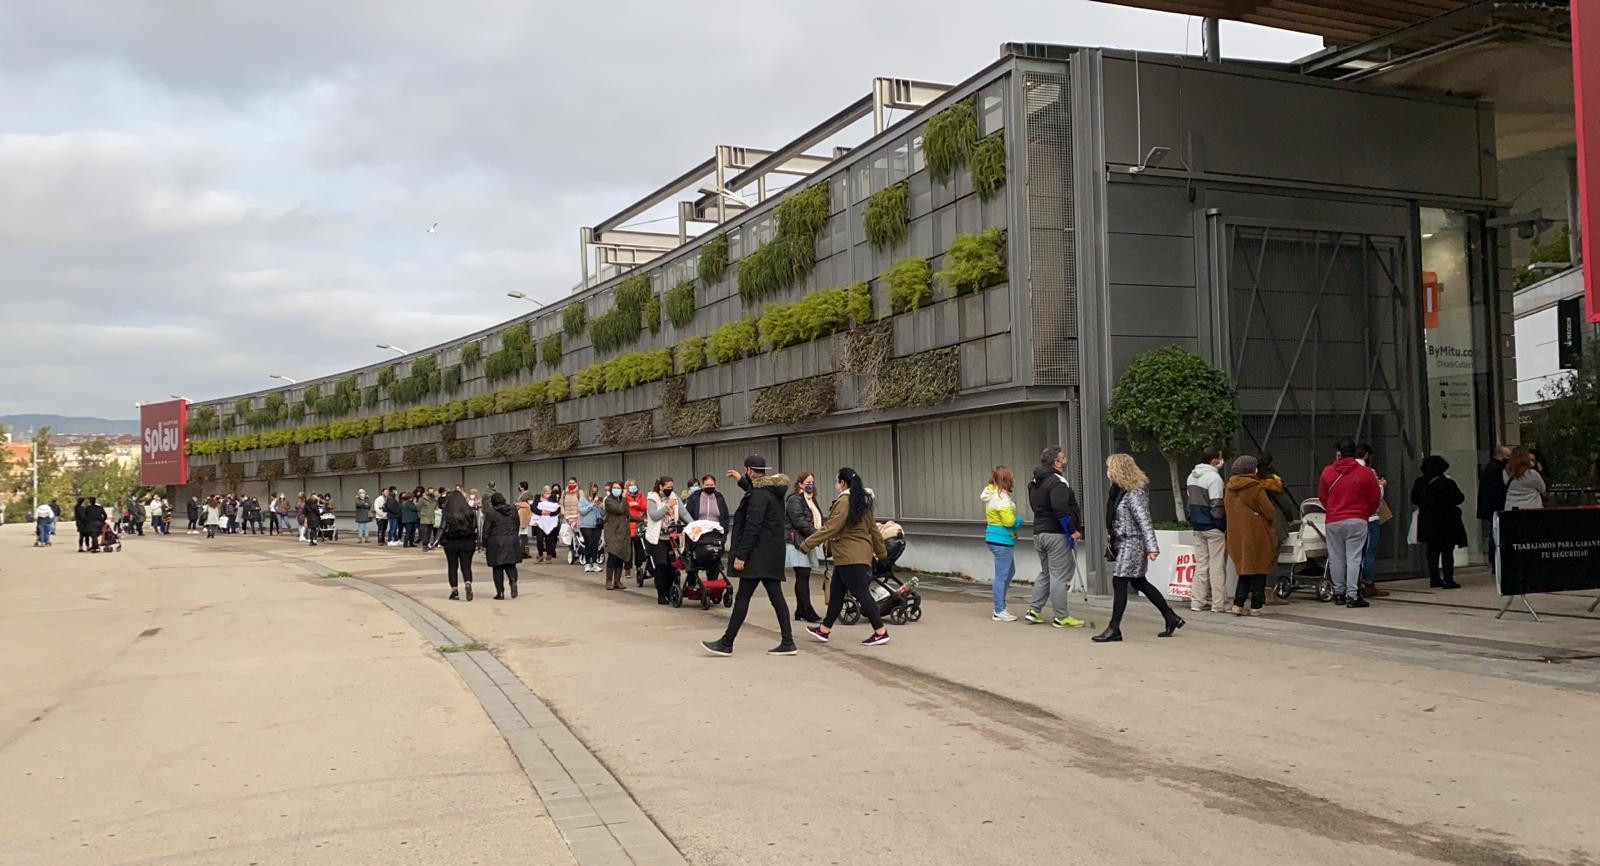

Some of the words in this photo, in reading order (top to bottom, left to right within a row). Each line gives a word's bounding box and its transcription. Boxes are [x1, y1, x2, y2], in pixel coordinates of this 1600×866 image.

[1429, 345, 1473, 358] ByMitu.co
[1512, 541, 1556, 551] TRABAJAMOS
[1541, 551, 1551, 559] TU
[1552, 550, 1589, 558] SEGURIDAD
